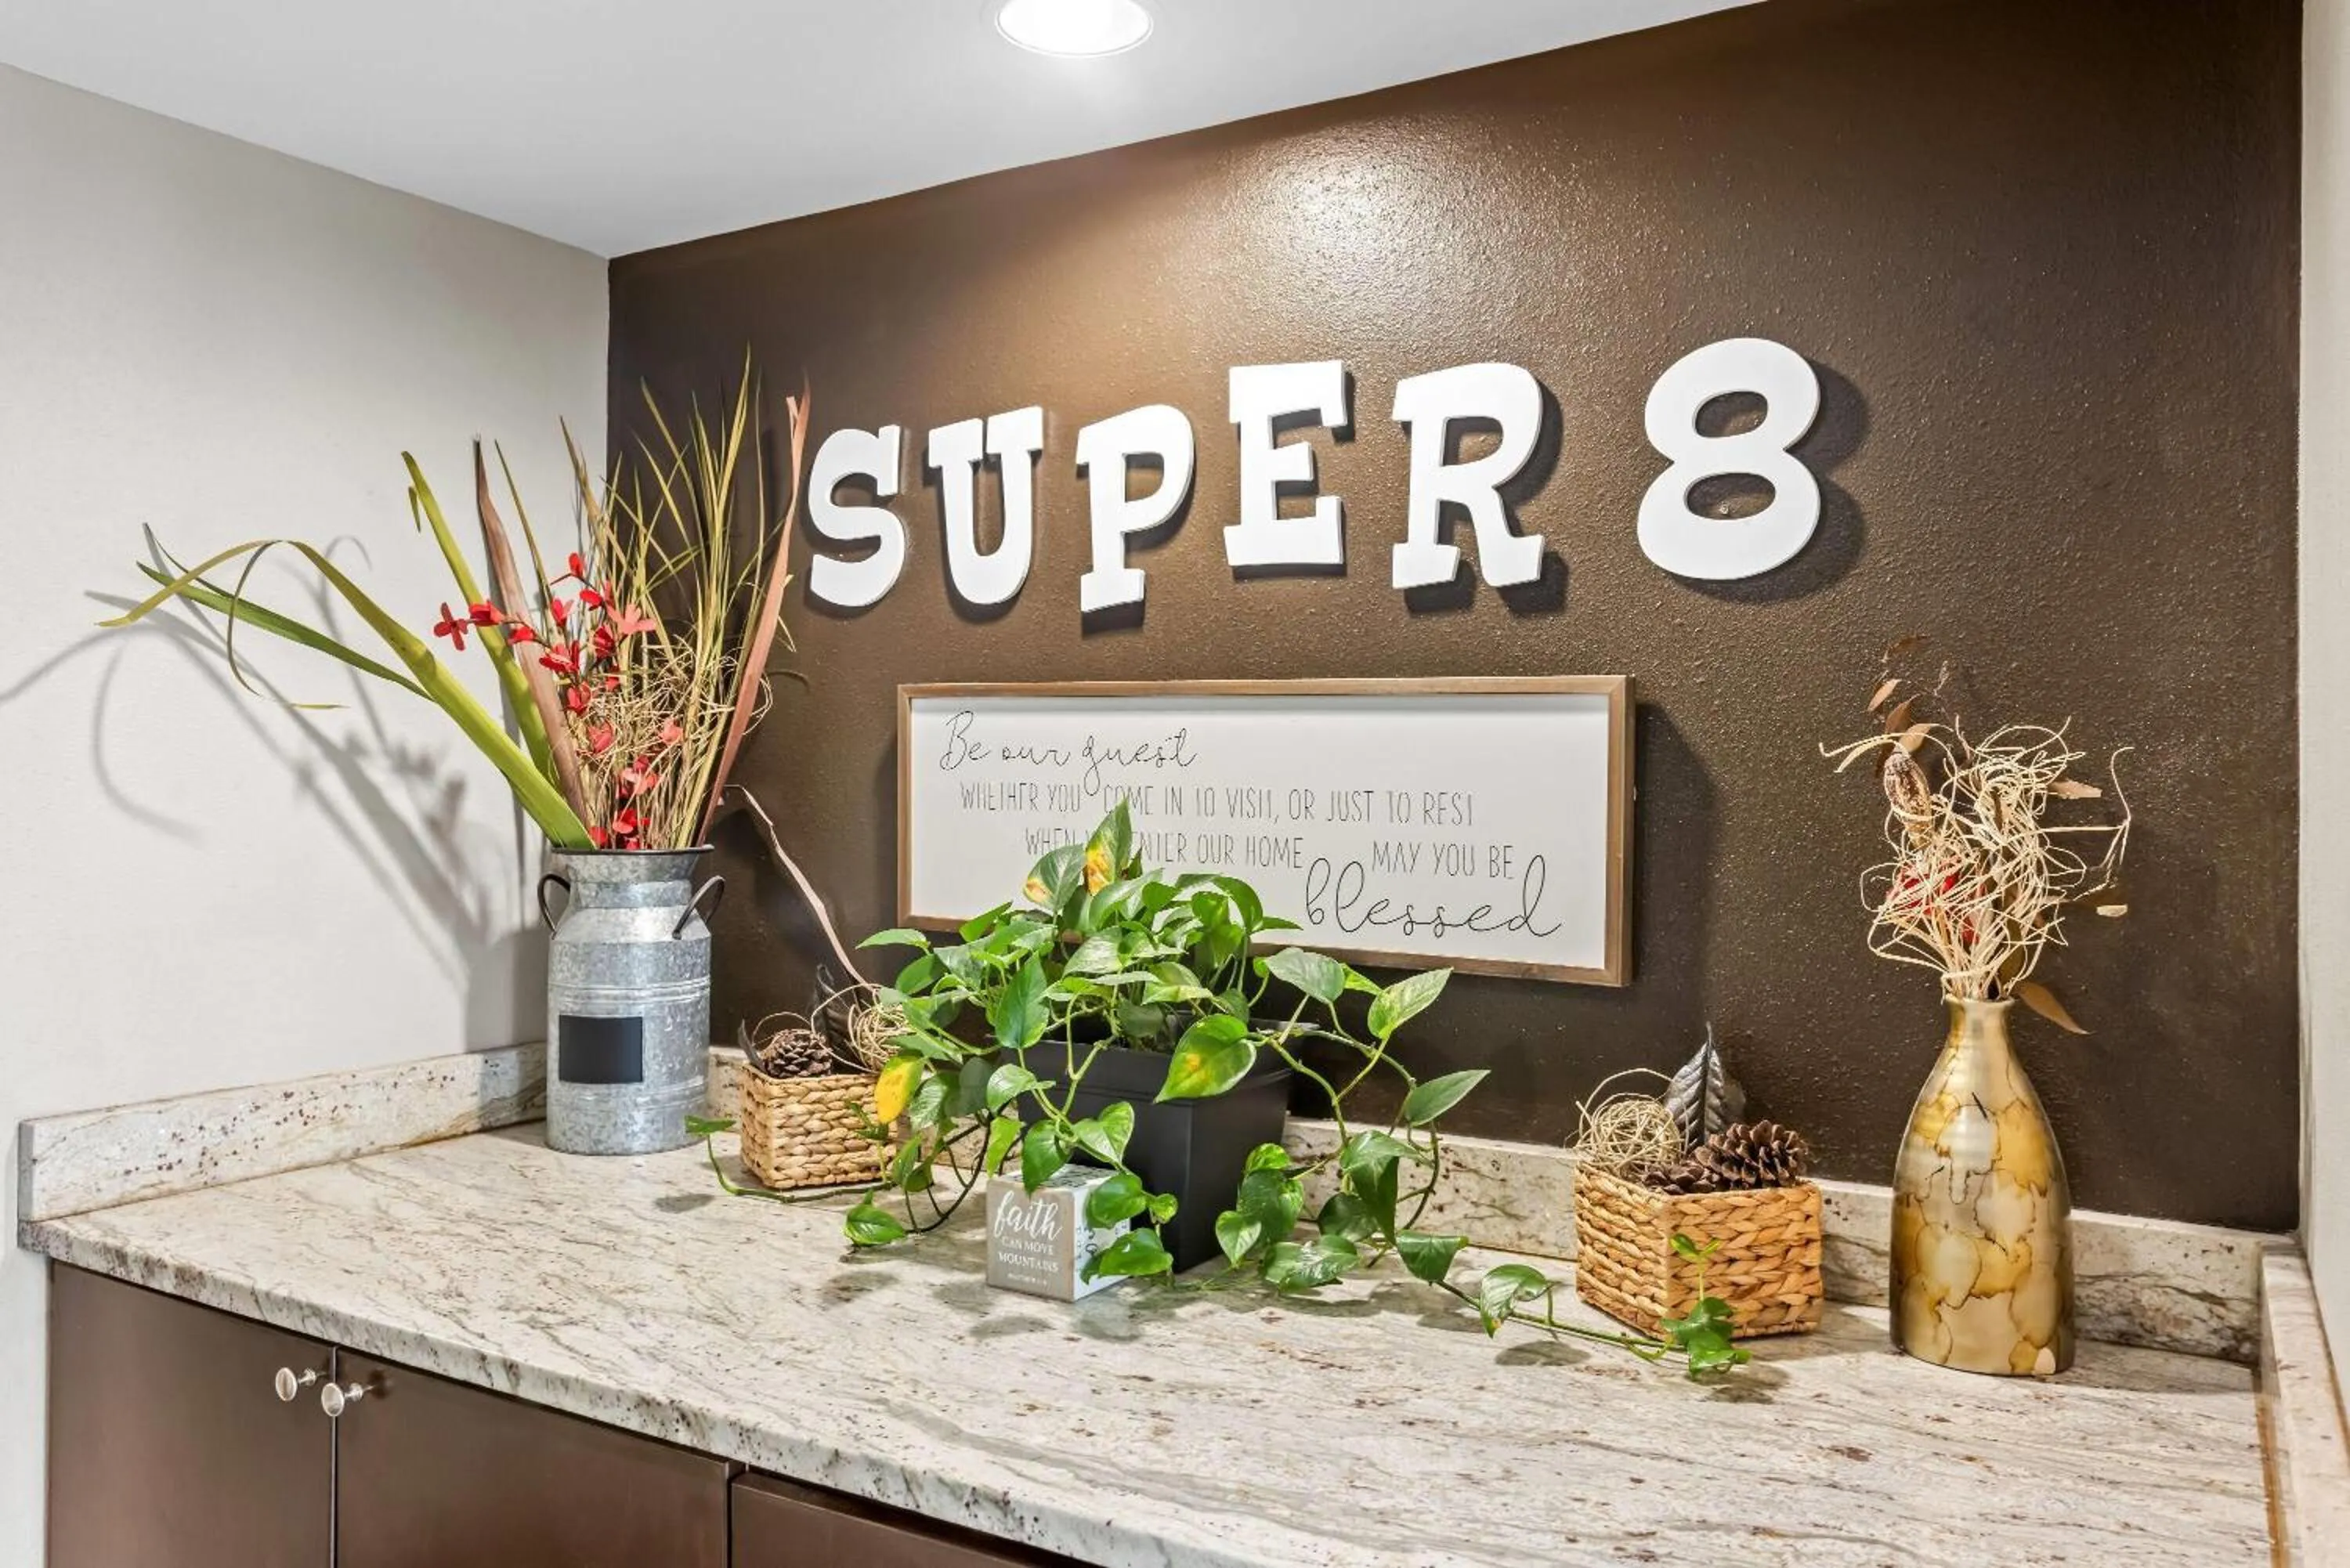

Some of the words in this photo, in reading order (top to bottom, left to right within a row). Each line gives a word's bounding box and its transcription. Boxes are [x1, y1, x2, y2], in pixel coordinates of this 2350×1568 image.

[808, 359, 1544, 612] SUPER
[1637, 337, 1820, 580] 8
[940, 710, 991, 771] Be
[1002, 745, 1071, 766] our
[1081, 728, 1198, 796] guest
[960, 781, 1039, 812] WHETHER
[1047, 782, 1081, 813] YOU
[1164, 786, 1182, 815] IN
[1194, 786, 1215, 818] TO
[1289, 788, 1315, 820] OR
[1327, 790, 1375, 822] JUST
[1386, 790, 1411, 824] TO
[1423, 791, 1473, 826] REST
[1131, 831, 1188, 863] NTER
[1197, 833, 1235, 865] OUR
[1246, 835, 1304, 869] HOME
[1372, 840, 1422, 875] MAY
[1433, 843, 1476, 876] YOU
[1489, 844, 1515, 880] BE
[1306, 854, 1562, 938] blessed
[994, 1190, 1063, 1241] faith
[998, 1251, 1059, 1273] MOUNTAINS
